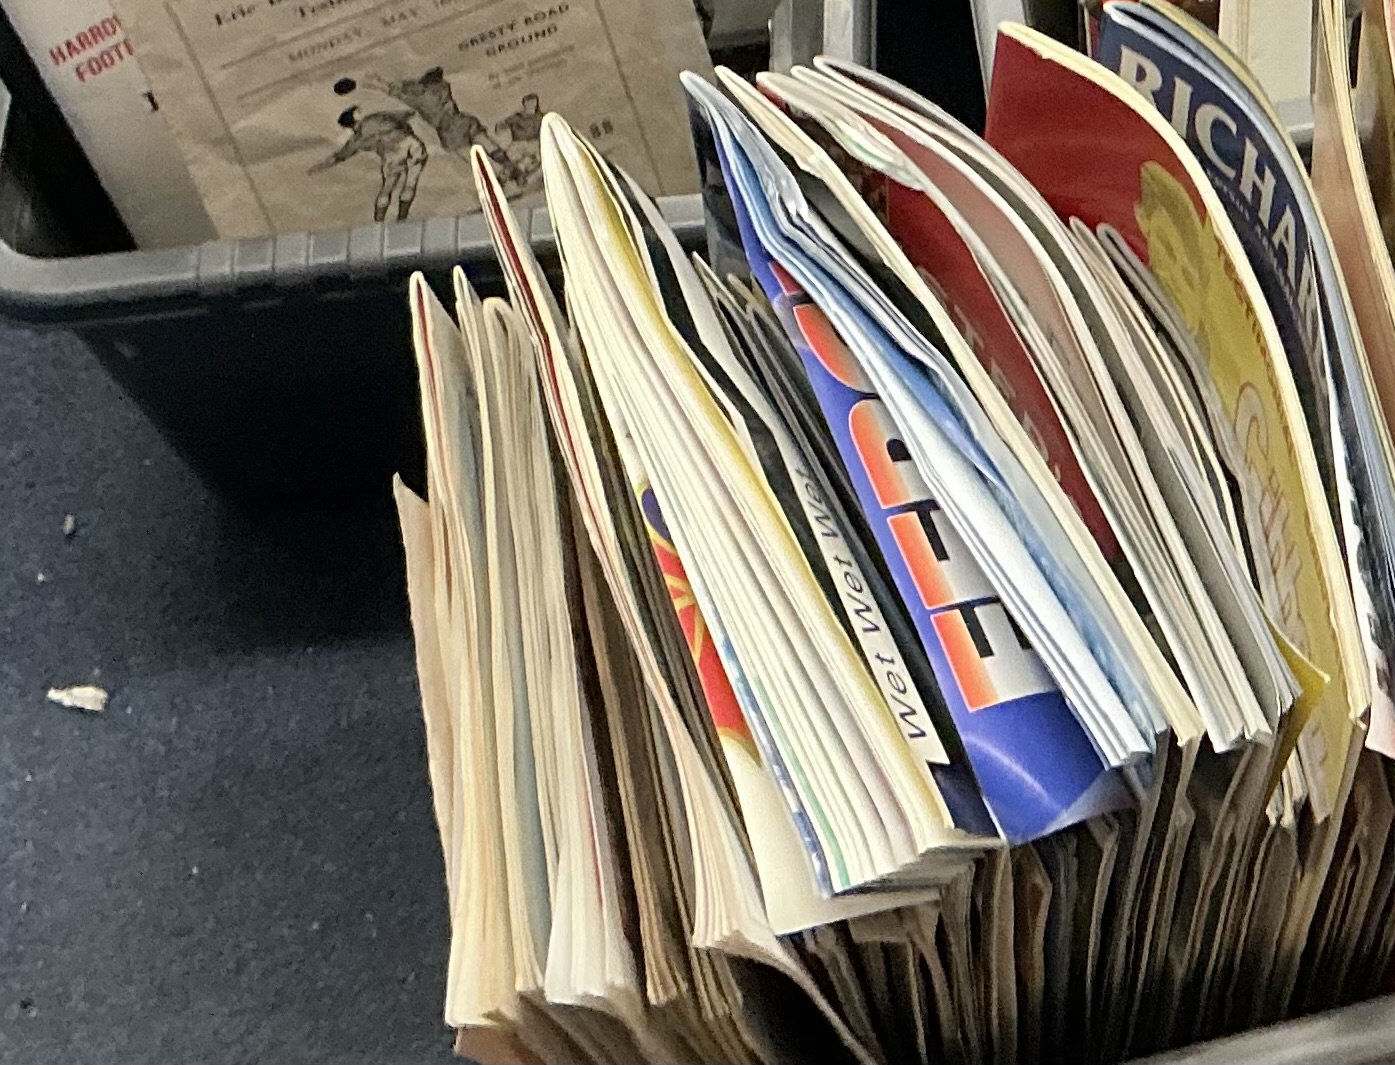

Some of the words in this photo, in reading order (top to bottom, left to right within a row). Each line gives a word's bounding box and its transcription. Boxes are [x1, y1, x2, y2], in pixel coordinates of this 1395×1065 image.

[49, 13, 122, 66] HARRO
[486, 23, 558, 57] GROUND
[524, 1, 569, 26] ROAD
[796, 466, 839, 538] Wet
[832, 554, 880, 634] Wet
[874, 652, 927, 739] Wet
